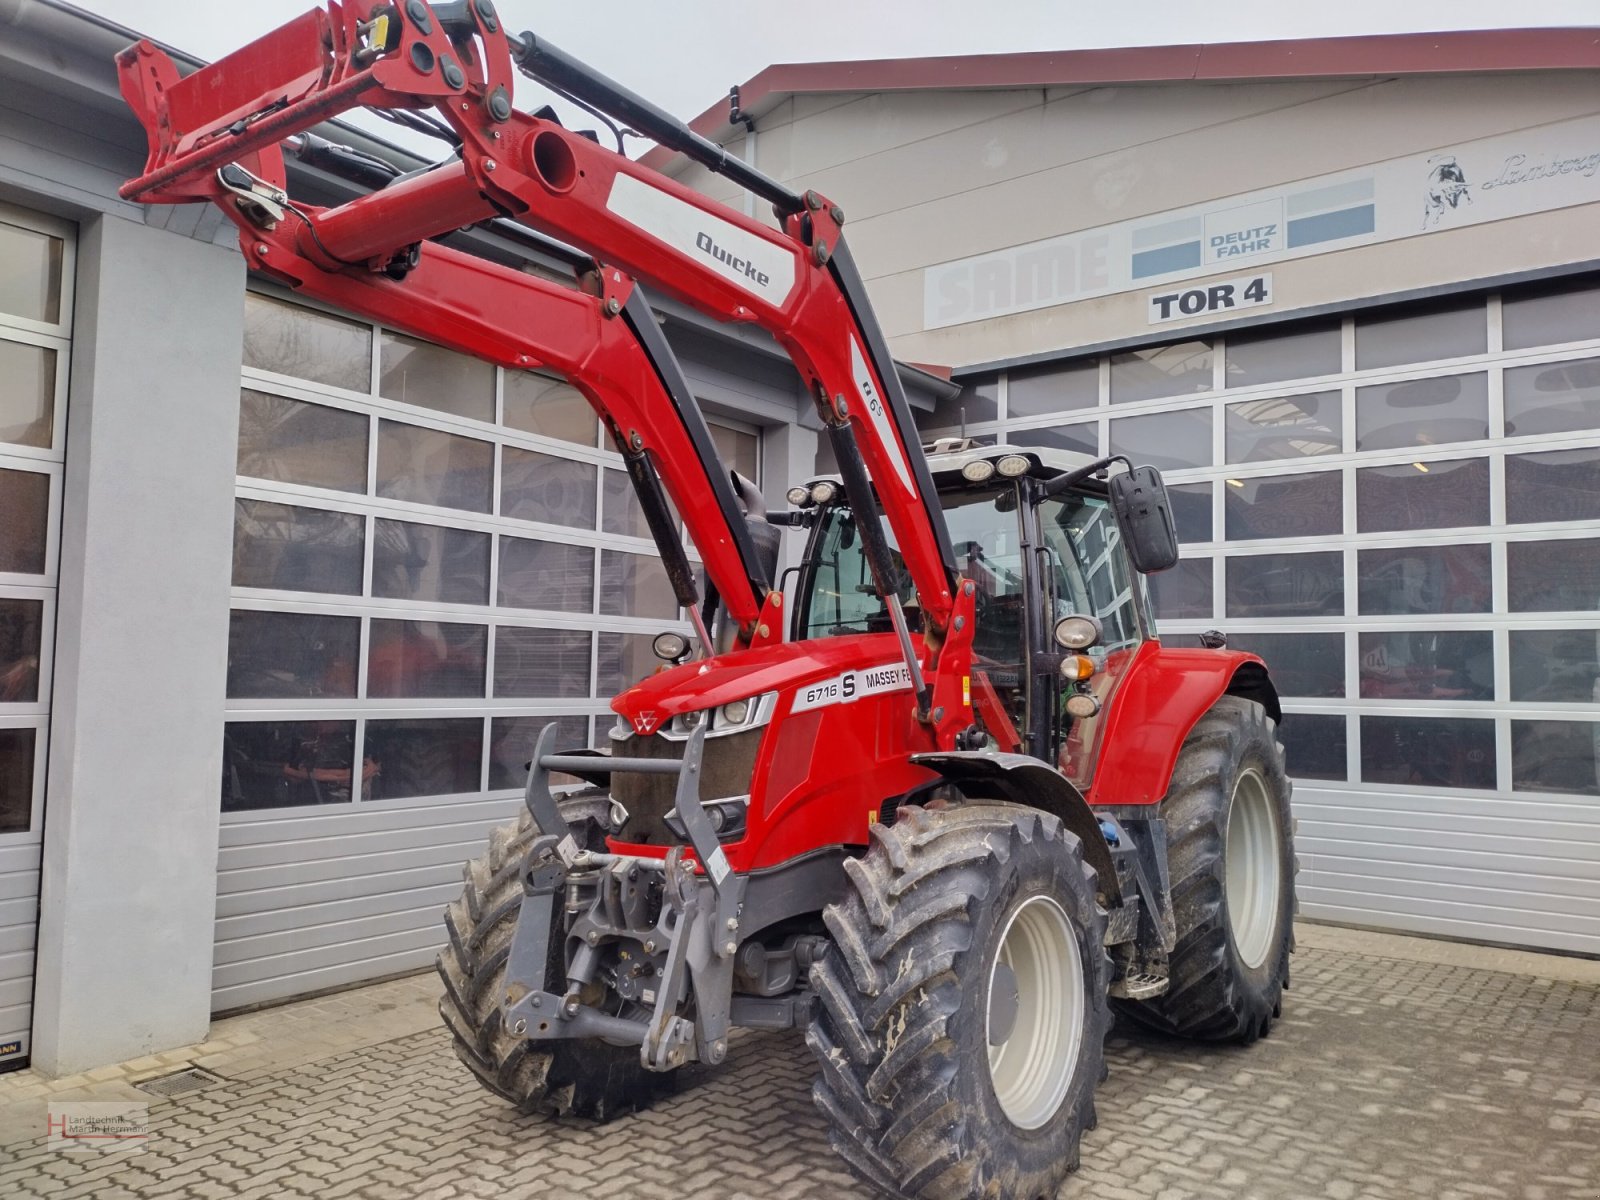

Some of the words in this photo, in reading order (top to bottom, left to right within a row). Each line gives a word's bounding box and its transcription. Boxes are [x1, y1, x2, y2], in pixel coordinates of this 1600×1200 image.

[1210, 224, 1277, 248] DEUTZ
[1216, 238, 1271, 259] FAHR
[696, 231, 769, 288] Quicke
[938, 233, 1110, 321] SAME
[1153, 285, 1235, 319] TOR
[1244, 277, 1268, 303] 4
[807, 684, 837, 703] 6716
[842, 674, 855, 697] S
[866, 670, 900, 689] MASSEY
